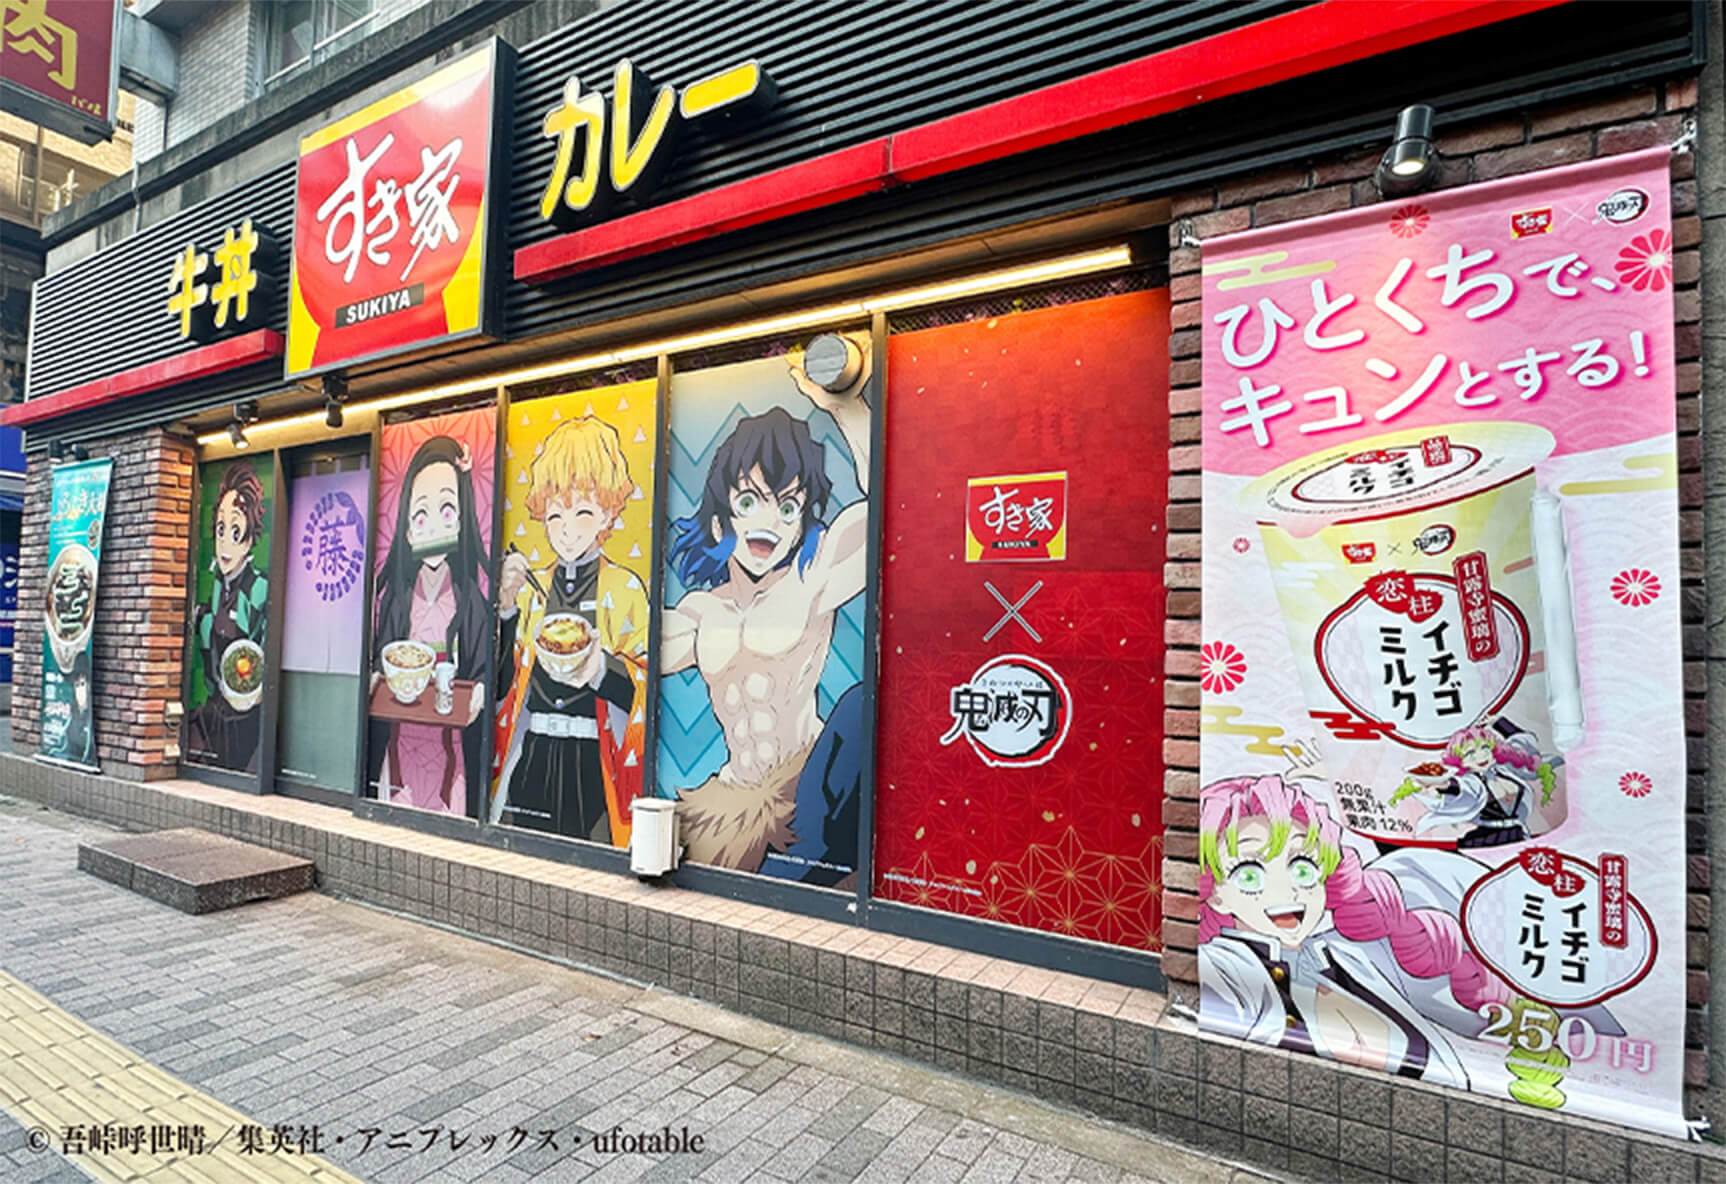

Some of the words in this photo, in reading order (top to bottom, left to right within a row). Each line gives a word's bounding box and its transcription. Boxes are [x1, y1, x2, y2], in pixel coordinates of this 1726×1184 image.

[541, 57, 761, 220] カレー
[316, 132, 463, 284] すき家
[167, 218, 259, 338] 牛丼
[346, 289, 412, 324] SUKIYA
[1214, 243, 1616, 369] ひとくちで、
[1219, 331, 1651, 448] キュンとする!
[316, 515, 350, 577] 藤
[979, 486, 1053, 539] すき家
[1376, 577, 1435, 617] 恋柱
[1379, 626, 1417, 720] ミルク
[1422, 620, 1463, 717] イチゴ
[942, 686, 1062, 744] 鬼滅の刃
[1527, 851, 1577, 893] 恋柱
[1518, 893, 1549, 978] ミルク
[1561, 902, 1590, 984] イチゴ
